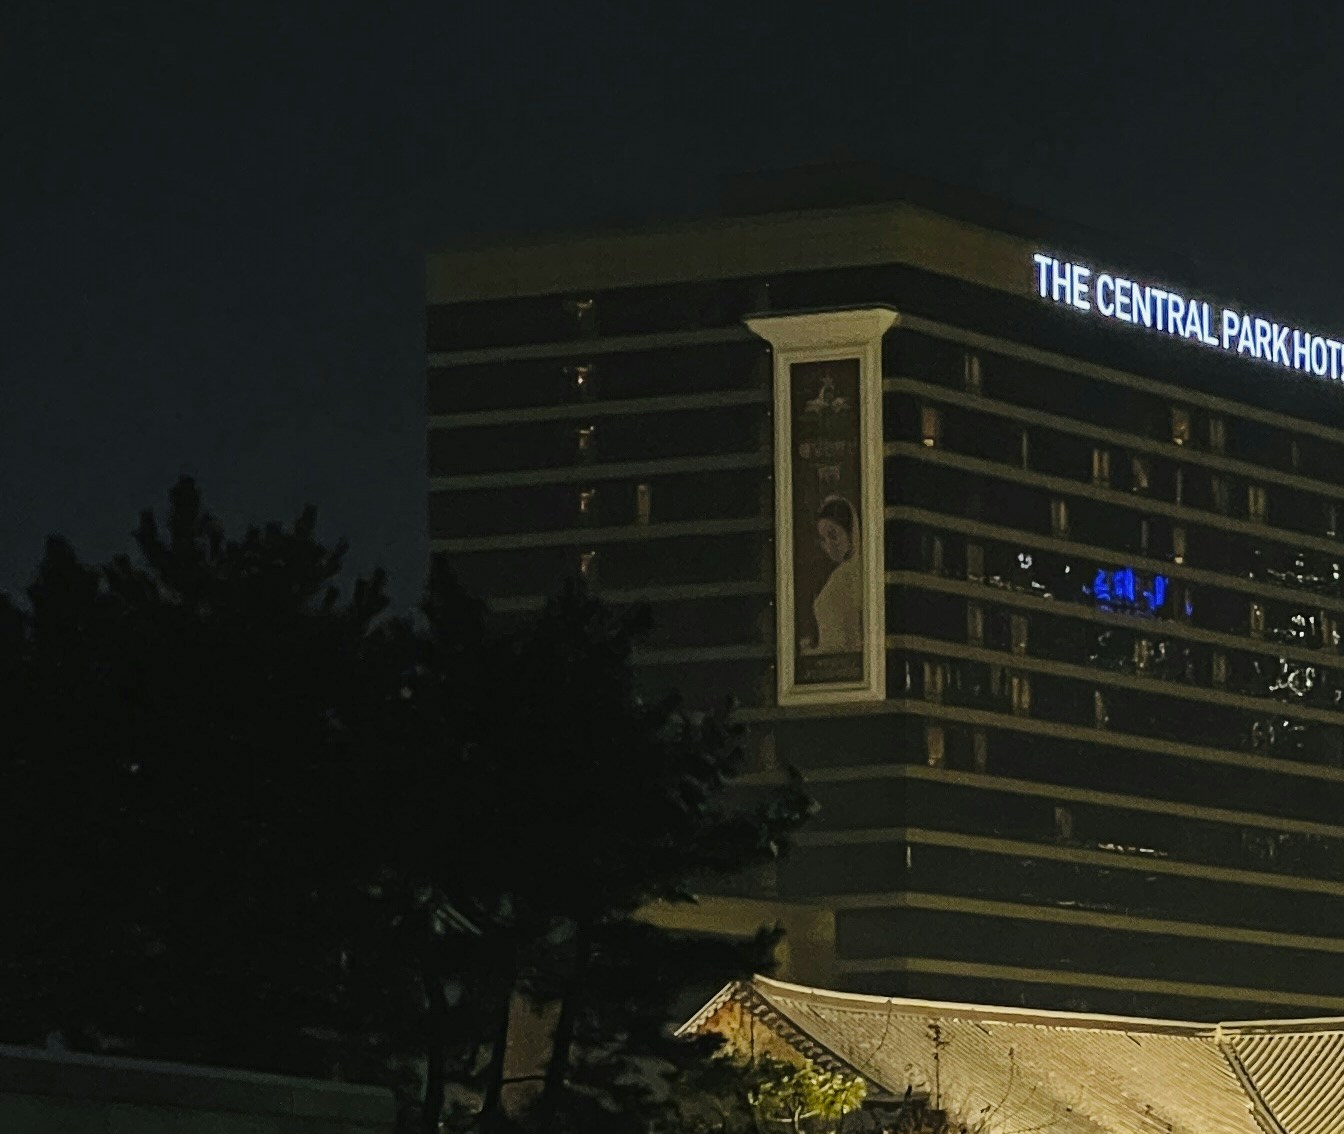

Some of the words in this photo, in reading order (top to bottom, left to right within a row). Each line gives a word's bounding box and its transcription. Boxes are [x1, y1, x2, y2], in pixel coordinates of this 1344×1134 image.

[1033, 252, 1091, 311] THE
[1096, 273, 1219, 347] CENTRAL
[1222, 308, 1292, 367] PARK
